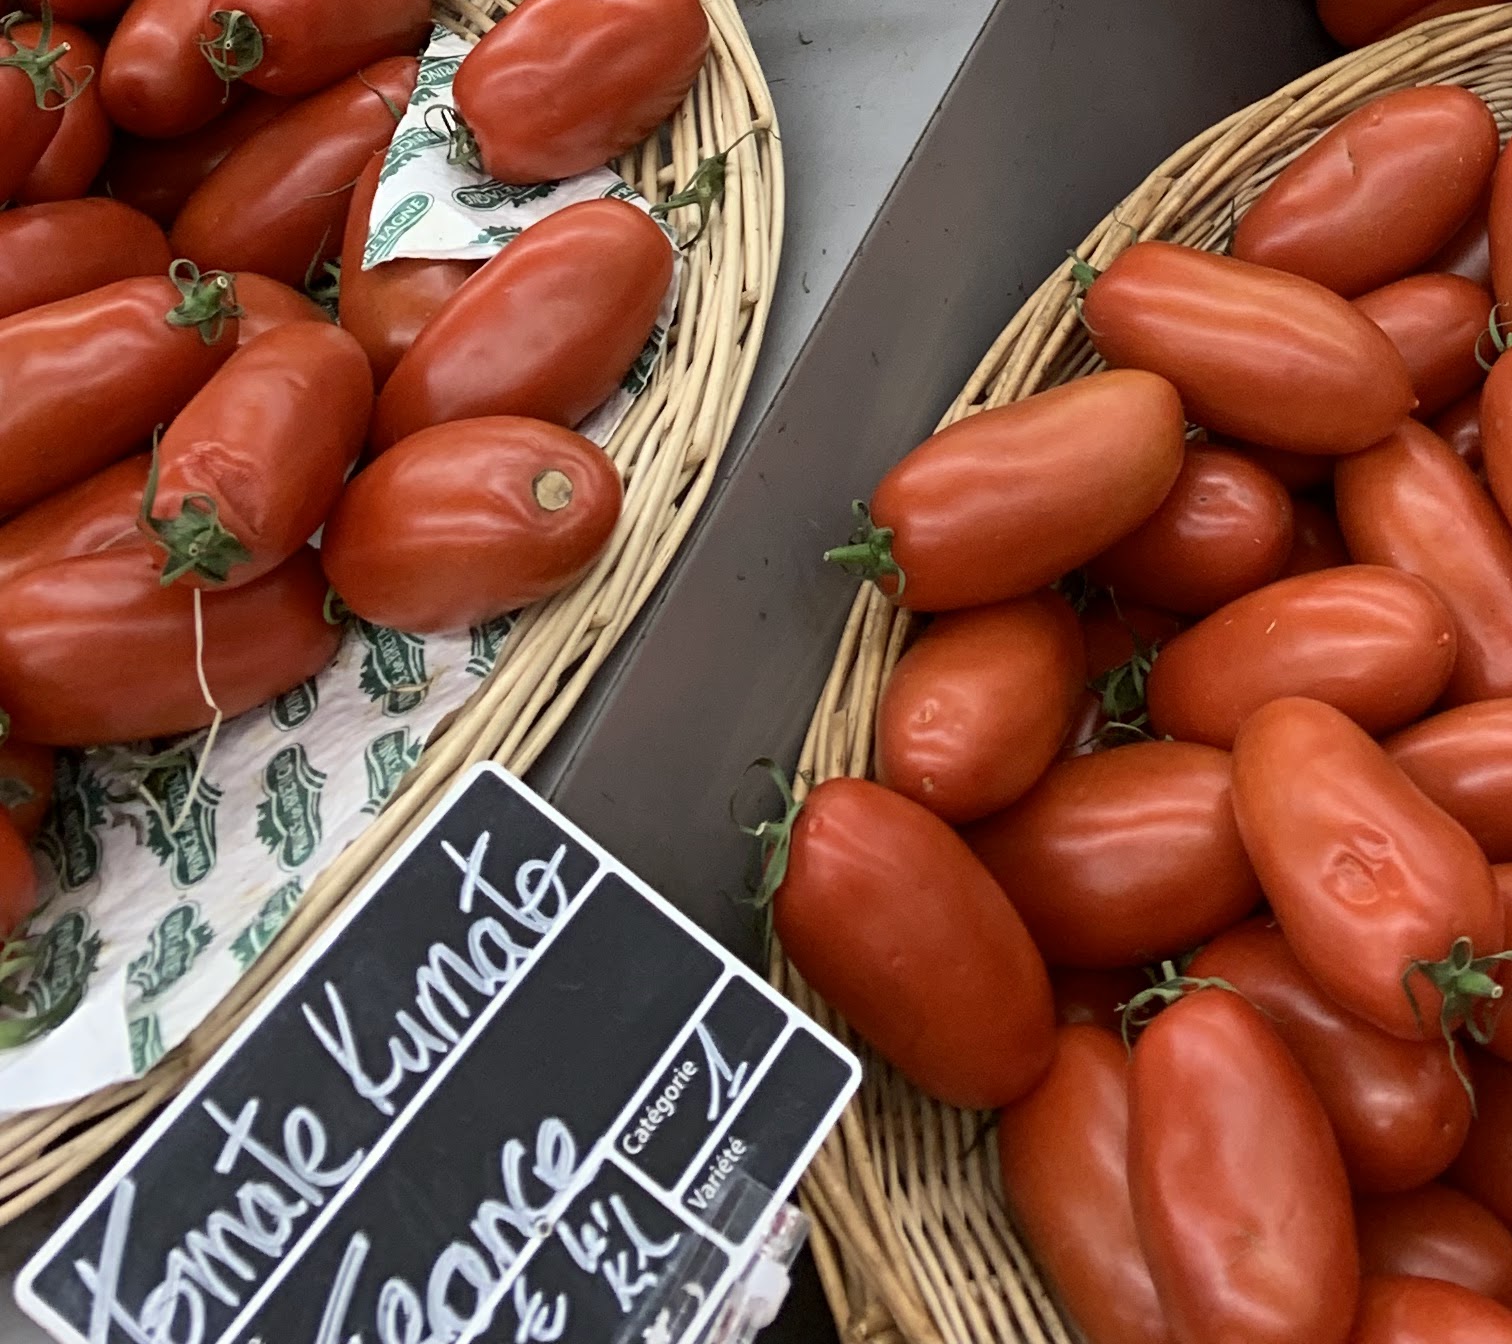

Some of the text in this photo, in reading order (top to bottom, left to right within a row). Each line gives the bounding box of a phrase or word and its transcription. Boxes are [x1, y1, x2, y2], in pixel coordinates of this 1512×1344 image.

[73, 830, 571, 1344] Tomate Kumato
[622, 1058, 699, 1156] Catégorie
[687, 1135, 748, 1212] Variété
